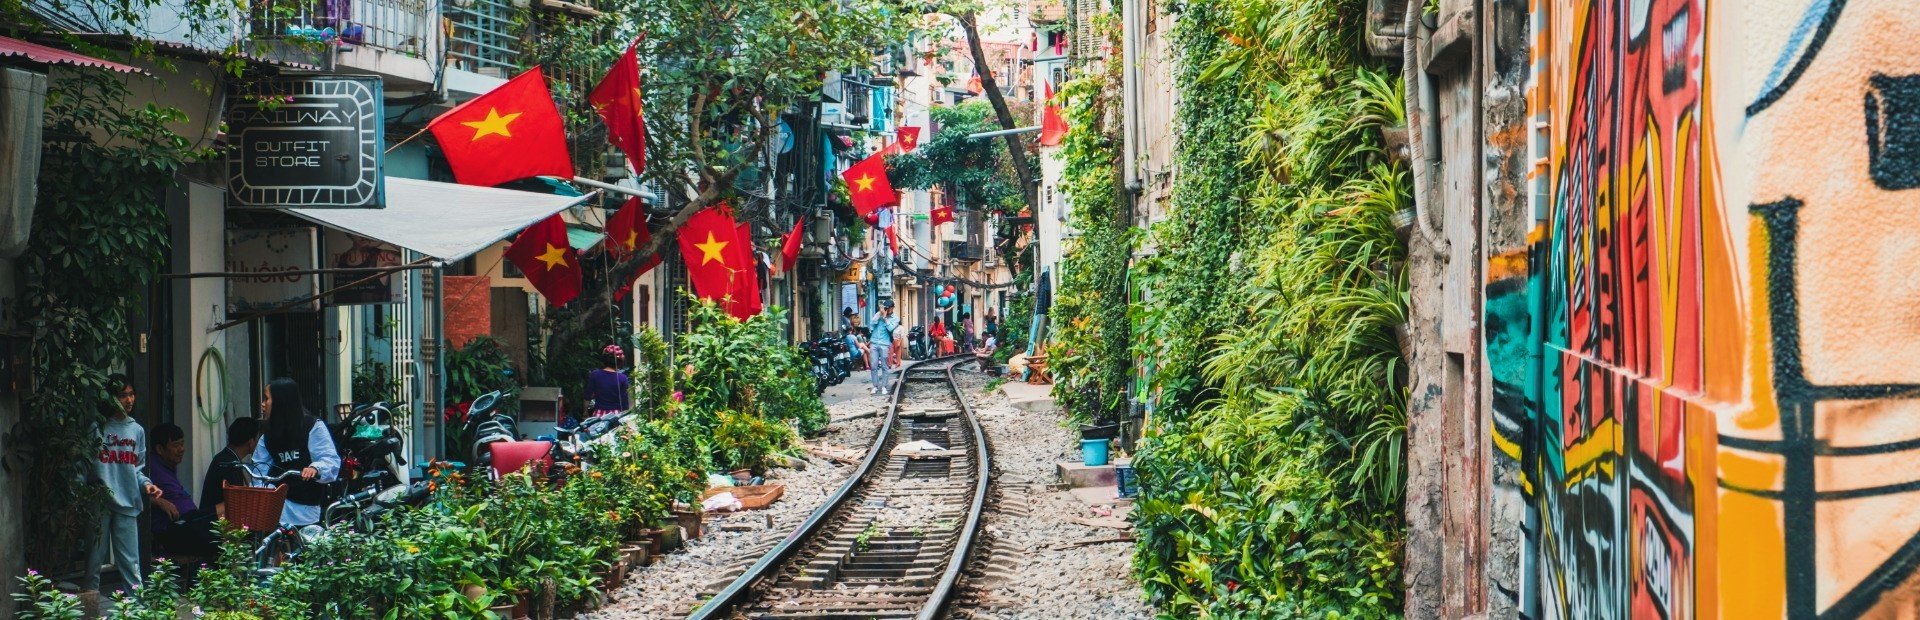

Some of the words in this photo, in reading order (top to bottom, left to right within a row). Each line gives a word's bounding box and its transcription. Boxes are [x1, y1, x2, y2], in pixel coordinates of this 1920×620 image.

[230, 110, 357, 124] RAILWAY
[254, 140, 331, 152] OUTFIT
[255, 155, 321, 167] STORE
[848, 267, 858, 277] 17
